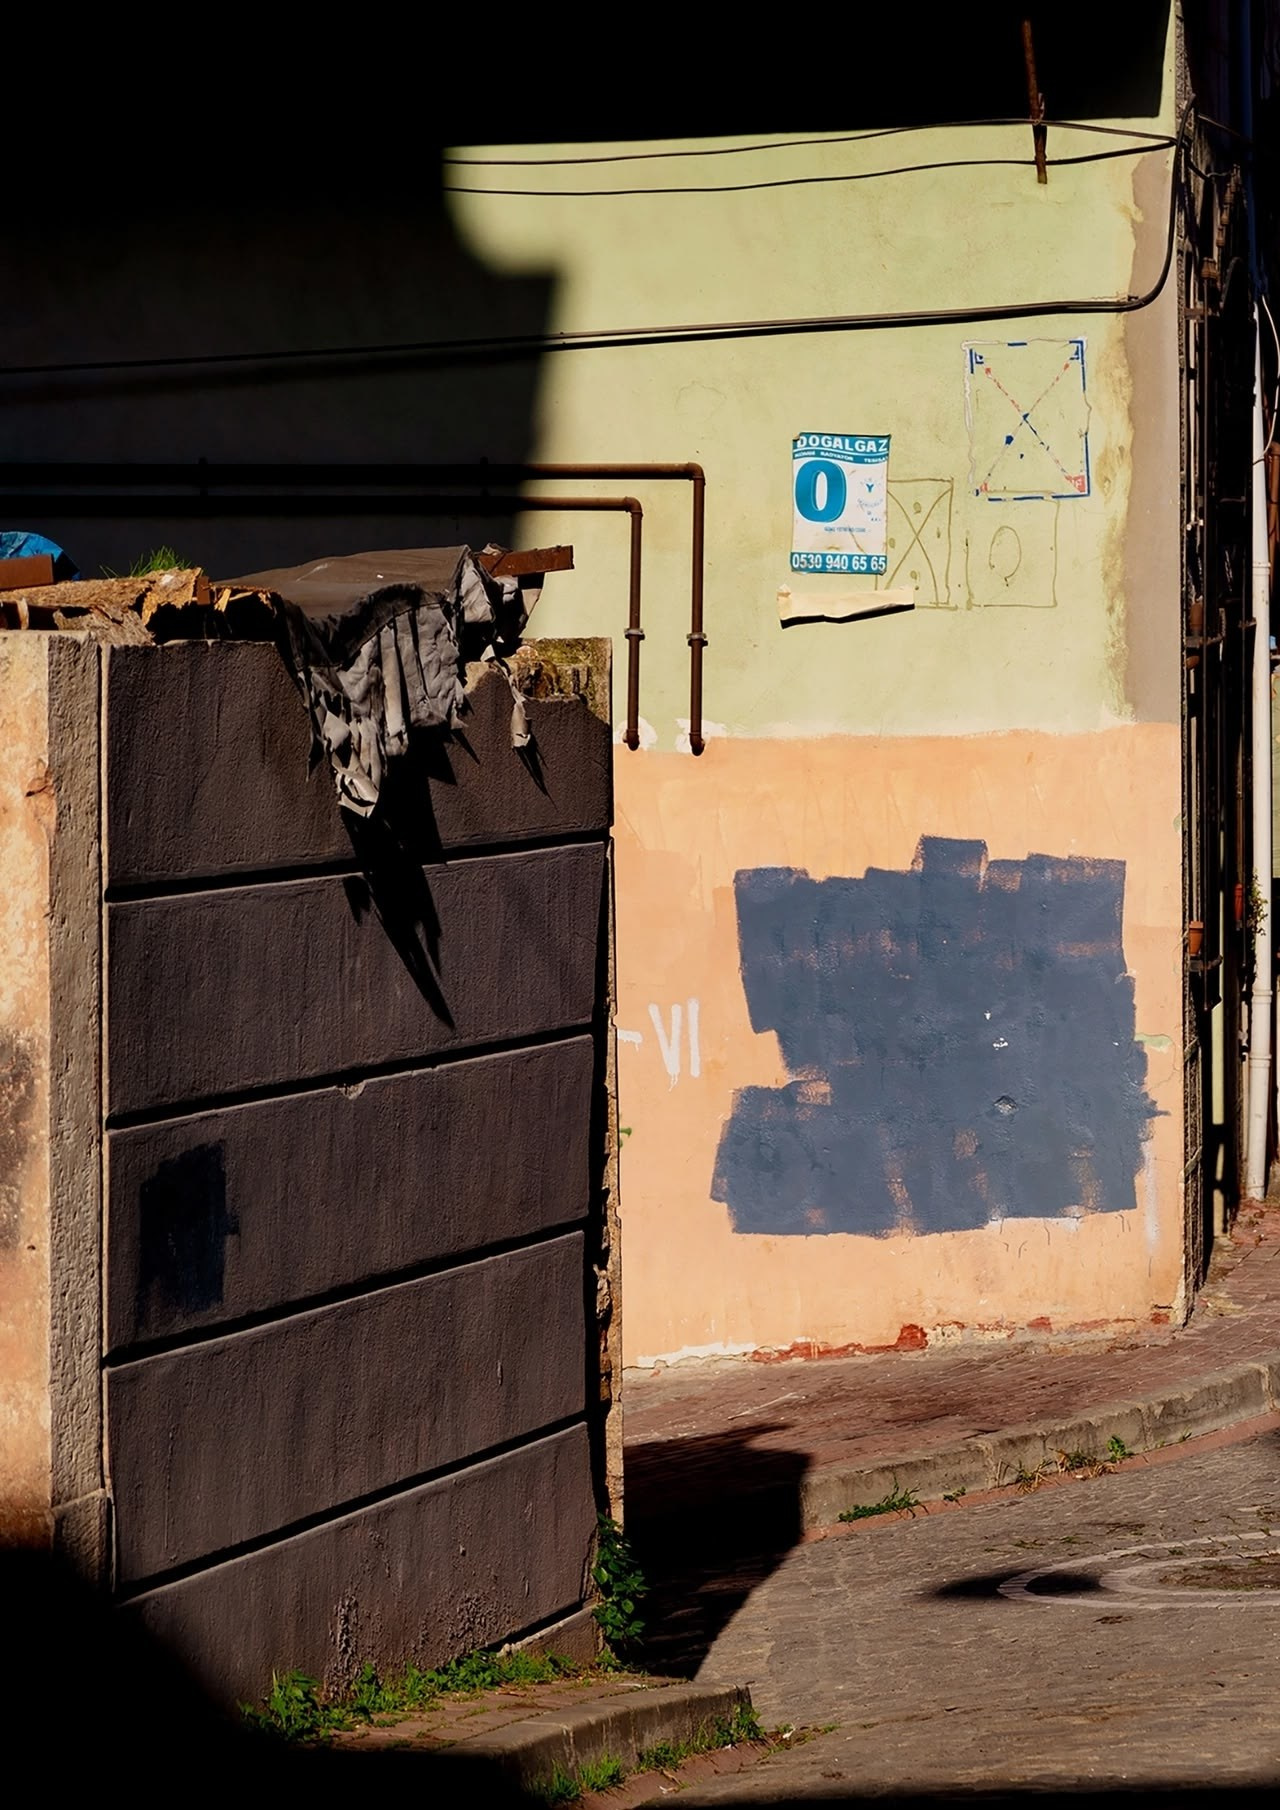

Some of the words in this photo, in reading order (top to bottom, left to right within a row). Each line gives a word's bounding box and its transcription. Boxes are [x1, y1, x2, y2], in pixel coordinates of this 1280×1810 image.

[792, 553, 822, 569] 0530
[825, 554, 849, 570] 940
[852, 556, 868, 571] 65
[870, 556, 886, 571] 65
